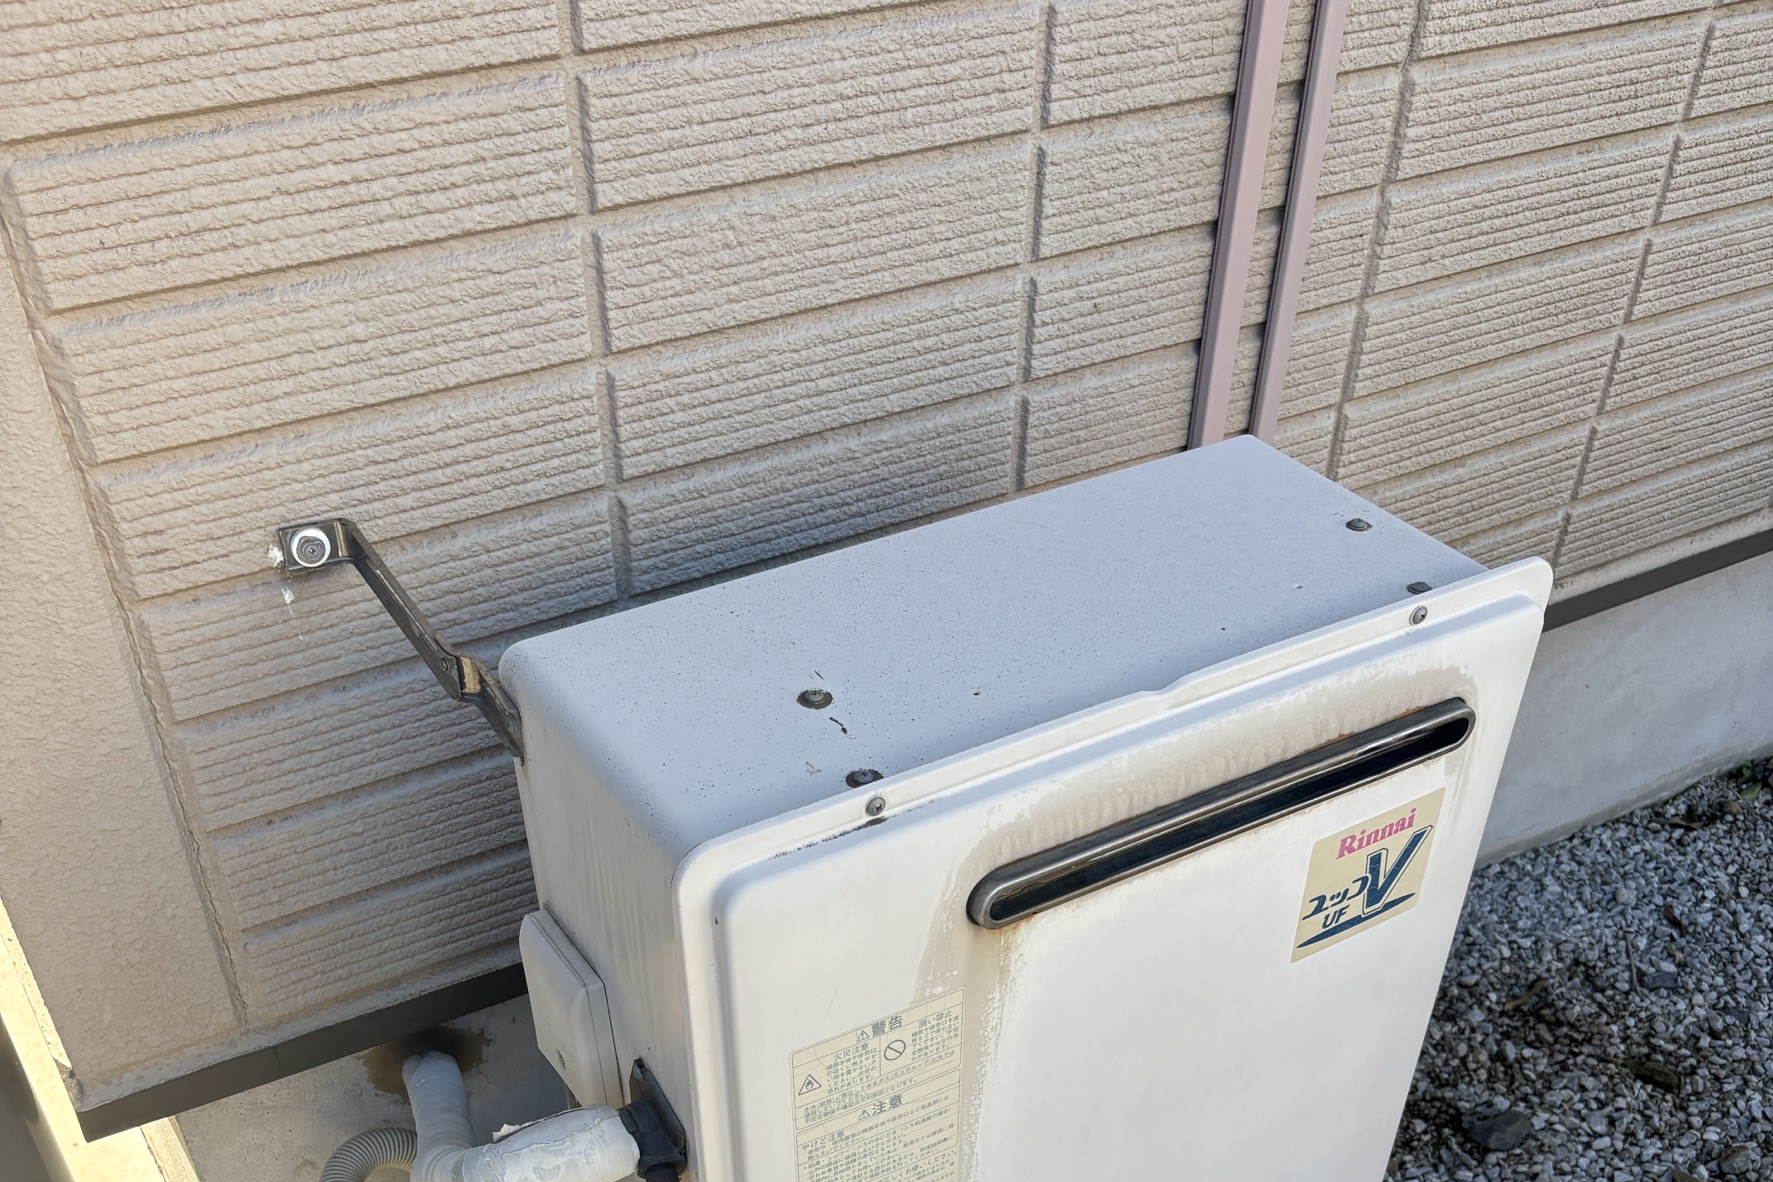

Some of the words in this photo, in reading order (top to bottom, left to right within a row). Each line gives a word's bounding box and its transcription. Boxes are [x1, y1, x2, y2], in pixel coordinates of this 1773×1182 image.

[1335, 807, 1418, 860] Rinnai
[1321, 904, 1351, 930] UF
[871, 1013, 902, 1038] 警告
[833, 1041, 869, 1062] 火災注意
[871, 1092, 902, 1117] 注意
